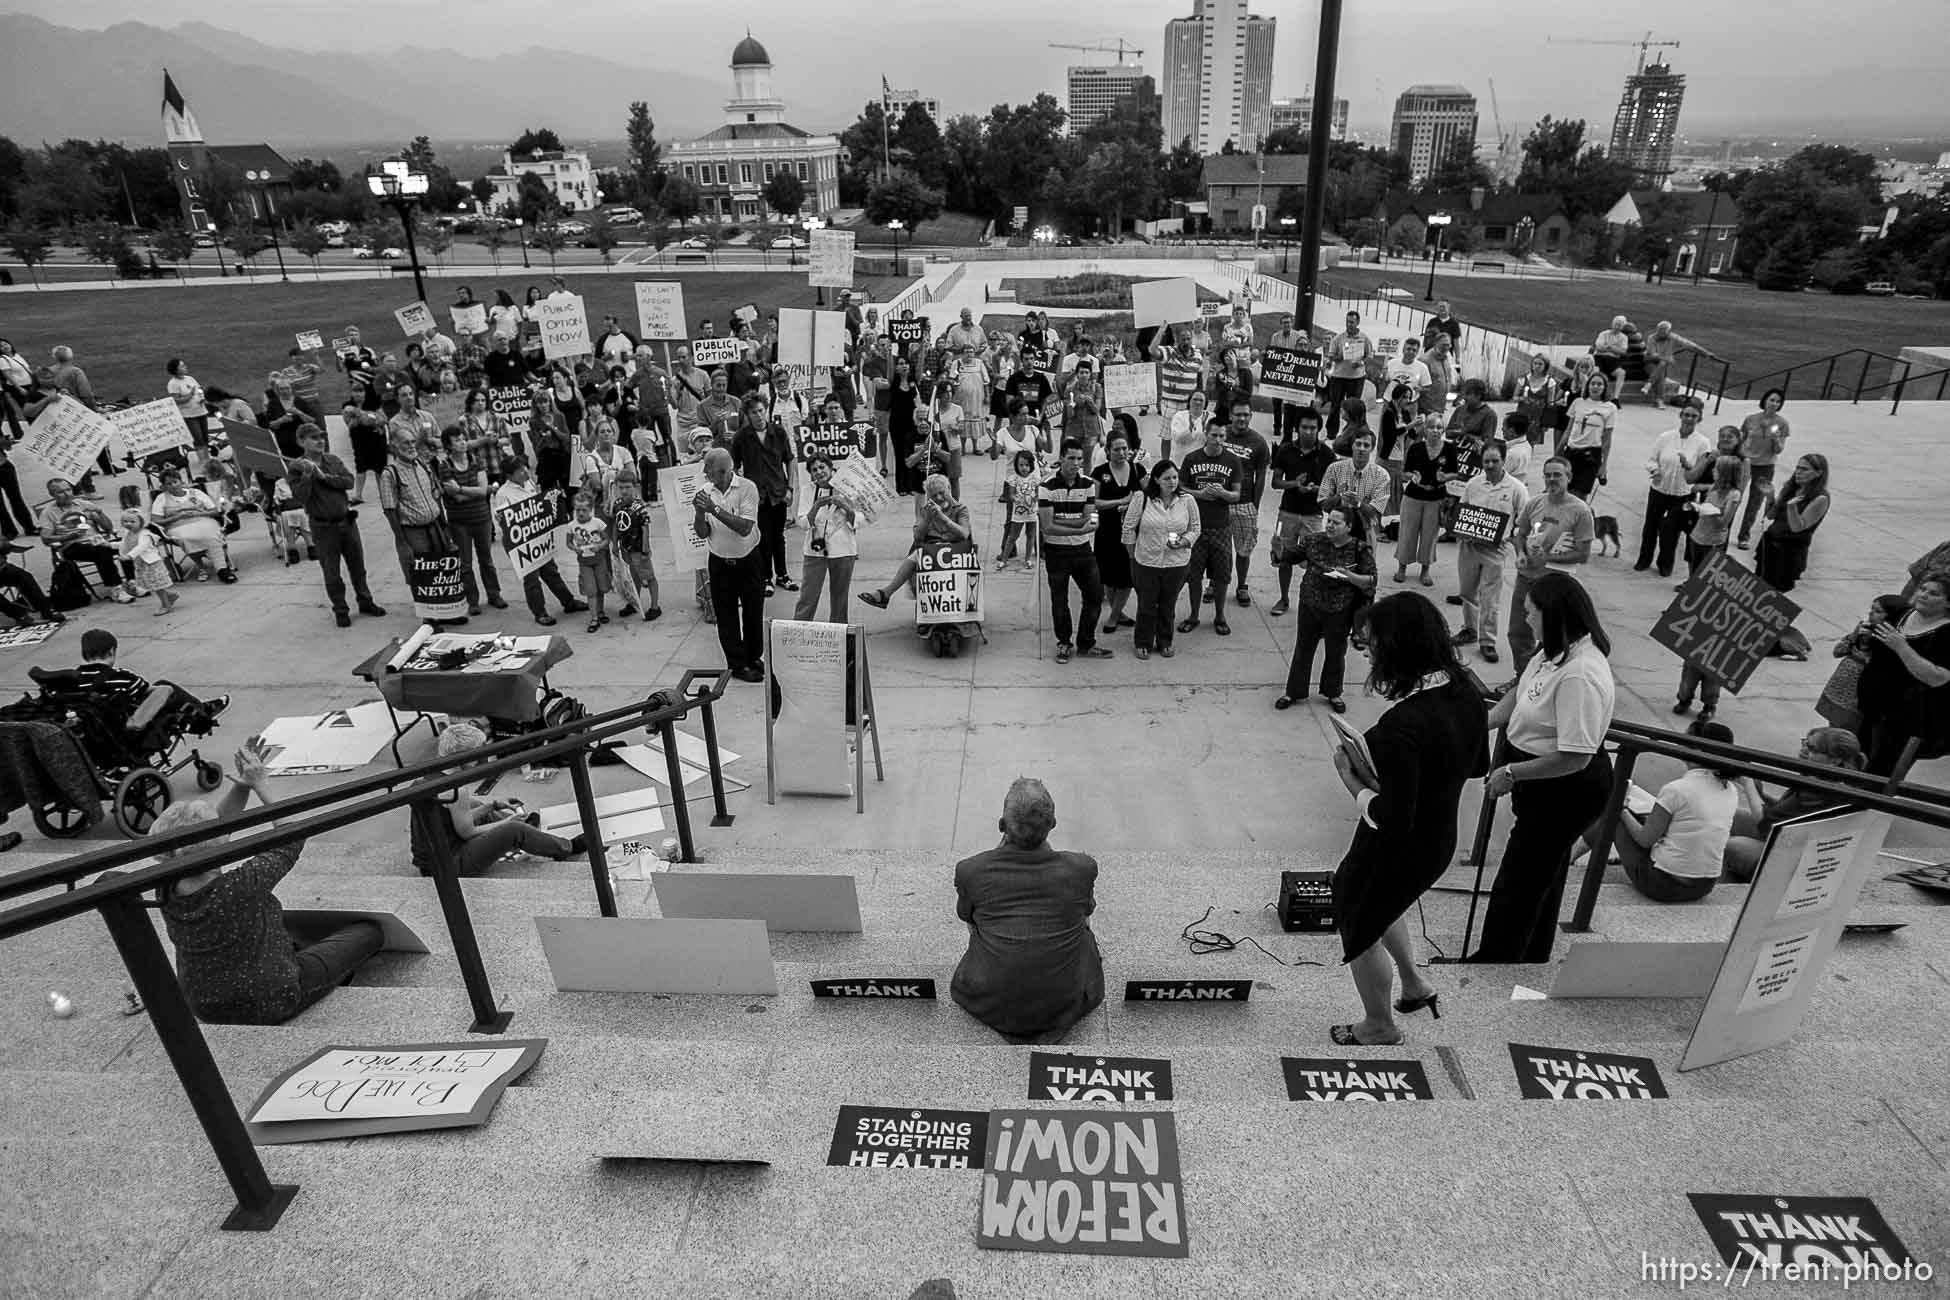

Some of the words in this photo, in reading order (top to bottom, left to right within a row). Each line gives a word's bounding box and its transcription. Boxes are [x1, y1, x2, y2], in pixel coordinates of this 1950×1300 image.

[543, 303, 575, 314] PUBLIC
[546, 317, 582, 330] OPTION
[892, 322, 921, 331] THANK
[893, 330, 922, 340] YOU
[695, 340, 732, 351] PUBLIC
[697, 344, 739, 361] OPTION!
[1276, 361, 1295, 373] shall
[1283, 352, 1318, 368] DREAM
[1263, 369, 1295, 383] NEVER
[489, 386, 527, 400] Public
[799, 424, 848, 442] Public
[504, 499, 544, 527] Public
[1458, 513, 1498, 529] TOGETHER
[1460, 508, 1501, 523] STANDING
[510, 513, 553, 544] Option
[1454, 522, 1496, 538] HEALTH
[517, 531, 556, 568] Now!
[1698, 551, 1754, 607] Health
[1752, 590, 1789, 630] Care
[928, 595, 961, 614] Wait
[1680, 585, 1777, 659] JUSTICE
[1669, 615, 1698, 648] 4
[1689, 635, 1750, 689] ALL!
[623, 848, 638, 856] FM
[826, 983, 921, 998] THANK
[1139, 986, 1236, 1000] THANK
[1047, 1066, 1155, 1089] THANK
[1300, 1070, 1413, 1090] THANK
[1528, 1057, 1646, 1086] THANK
[857, 1117, 972, 1136] STANDING
[855, 1131, 970, 1150] TOGETHER
[993, 1117, 1159, 1175] NOW!
[849, 1150, 969, 1169] HEALTH
[982, 1173, 1181, 1244] REFORM
[1718, 1212, 1878, 1242] THANK
